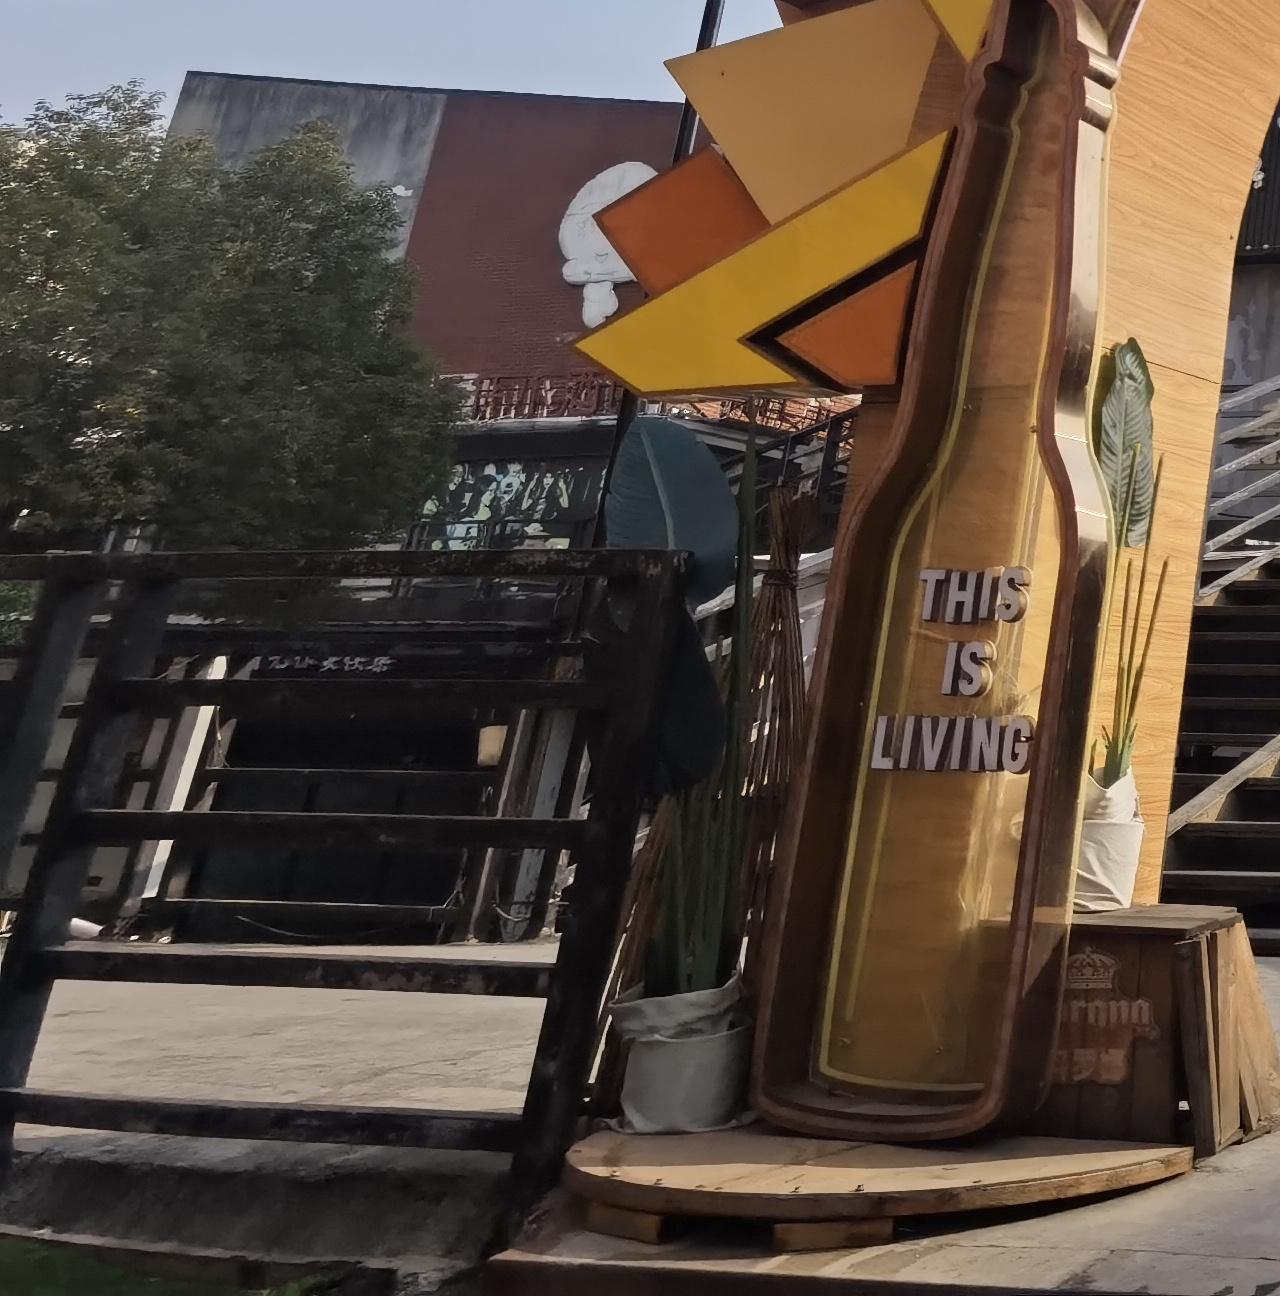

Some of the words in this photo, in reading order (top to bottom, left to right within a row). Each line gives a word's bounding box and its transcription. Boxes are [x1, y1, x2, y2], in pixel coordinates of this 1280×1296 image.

[919, 565, 1032, 623] THIS
[941, 640, 996, 696] IS
[871, 714, 1035, 774] LIVING
